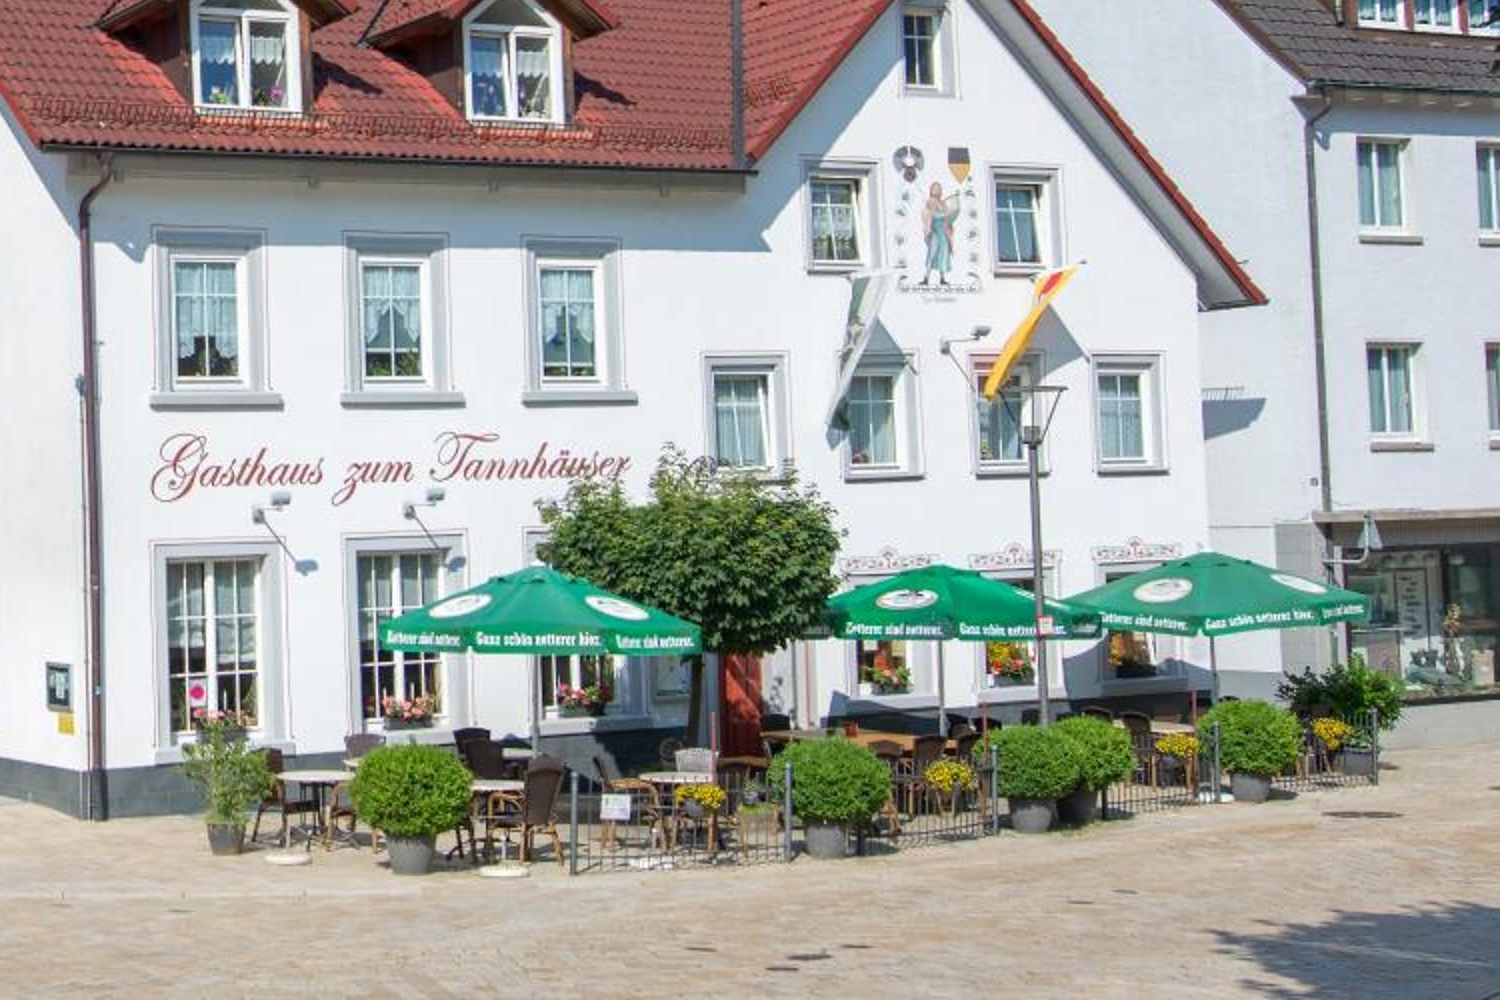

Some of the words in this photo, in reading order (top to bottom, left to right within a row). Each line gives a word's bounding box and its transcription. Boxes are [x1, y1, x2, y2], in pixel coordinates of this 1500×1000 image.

[149, 431, 325, 503] Gasthaus
[331, 459, 414, 507] zum
[428, 430, 632, 483] Tannhäuser
